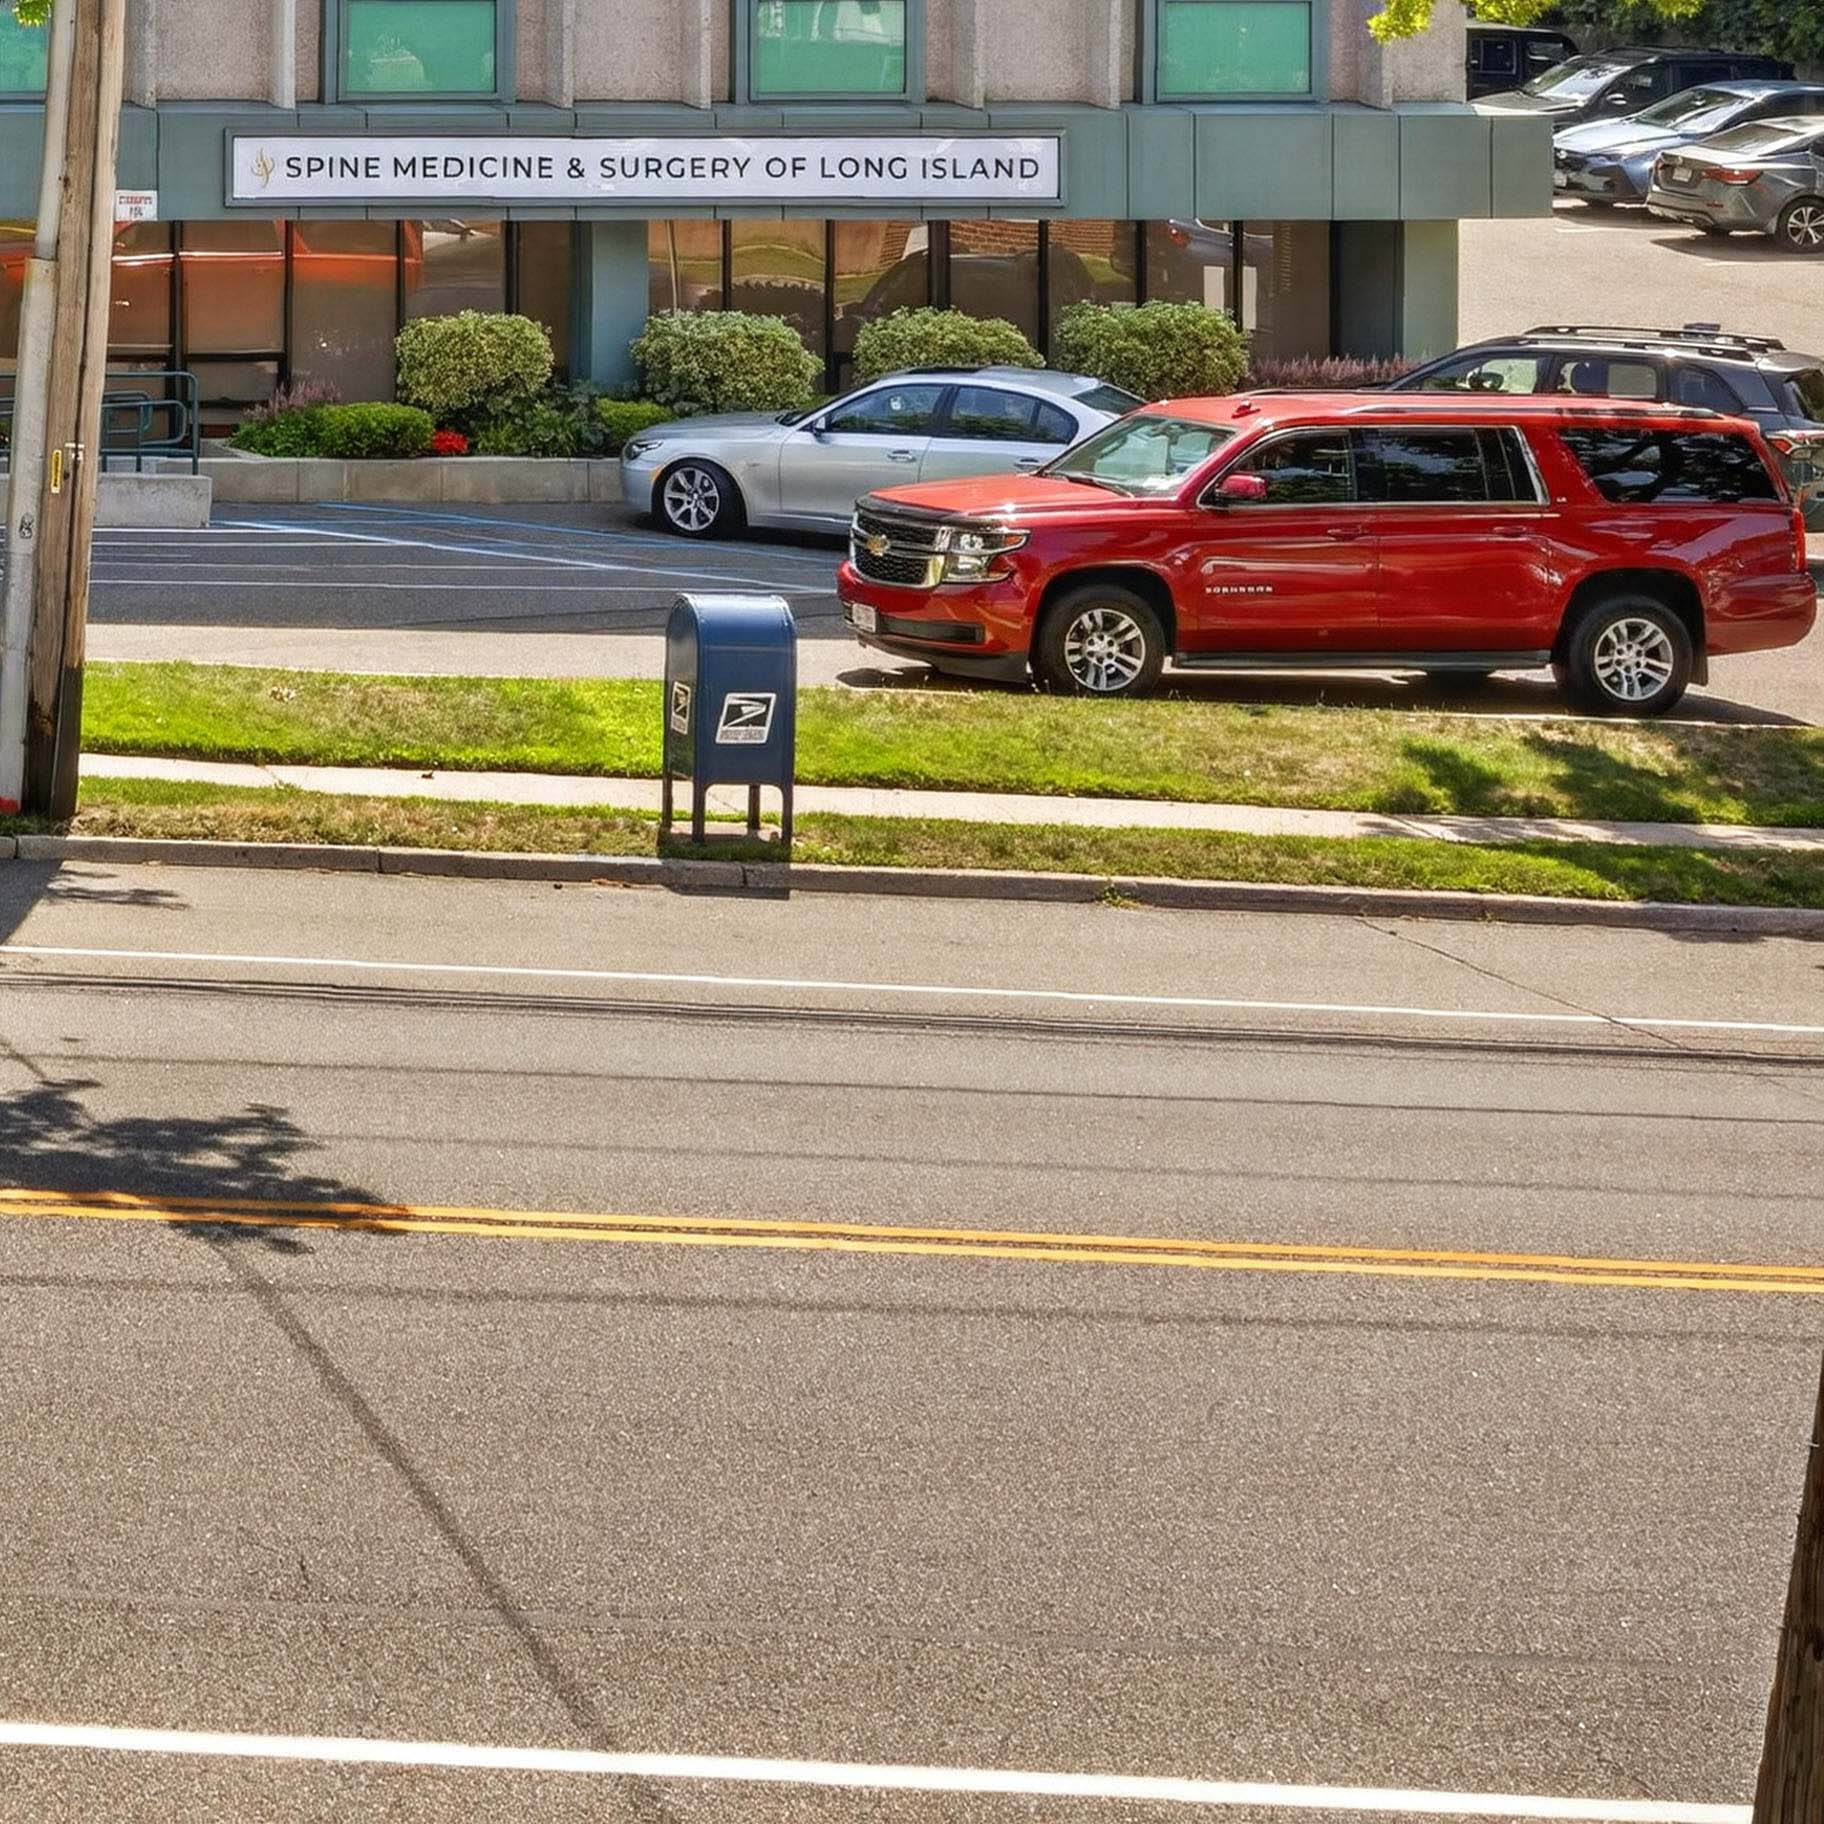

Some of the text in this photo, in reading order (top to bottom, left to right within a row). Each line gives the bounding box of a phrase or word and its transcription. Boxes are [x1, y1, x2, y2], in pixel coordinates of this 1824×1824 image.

[286, 156, 1039, 180] SPINE MEDICINE & SURGERY OF LONG ISLAND
